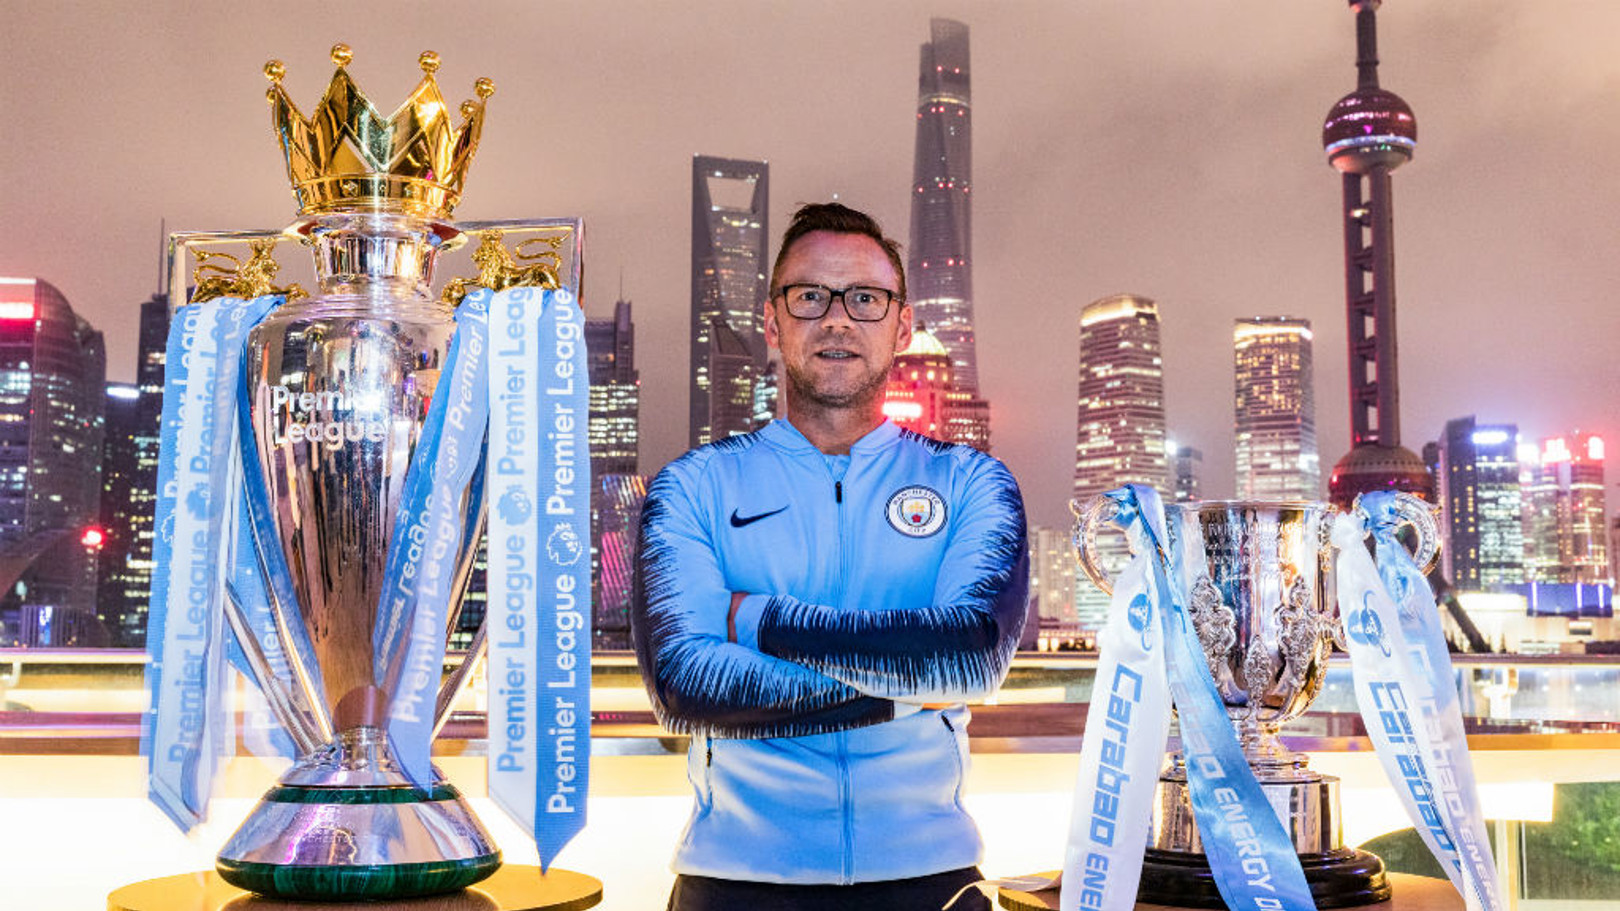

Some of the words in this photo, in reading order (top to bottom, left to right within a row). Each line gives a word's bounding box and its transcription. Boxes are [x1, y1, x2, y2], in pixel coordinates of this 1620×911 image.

[449, 326, 484, 431] Premier
[546, 287, 581, 396] League
[272, 385, 356, 414] Premi
[273, 420, 386, 450] League
[496, 366, 526, 476] Premier
[545, 403, 575, 516] Premier
[391, 606, 437, 724] Premier
[425, 484, 456, 600] League
[498, 534, 533, 649] League
[547, 574, 583, 689] League
[168, 648, 203, 763] Premier
[496, 657, 526, 773] Premier
[546, 697, 577, 814] Premier
[1089, 663, 1143, 848] Carabao
[1080, 852, 1109, 911] ENE
[1214, 787, 1276, 891] ENERGY
[1253, 895, 1275, 911] D
